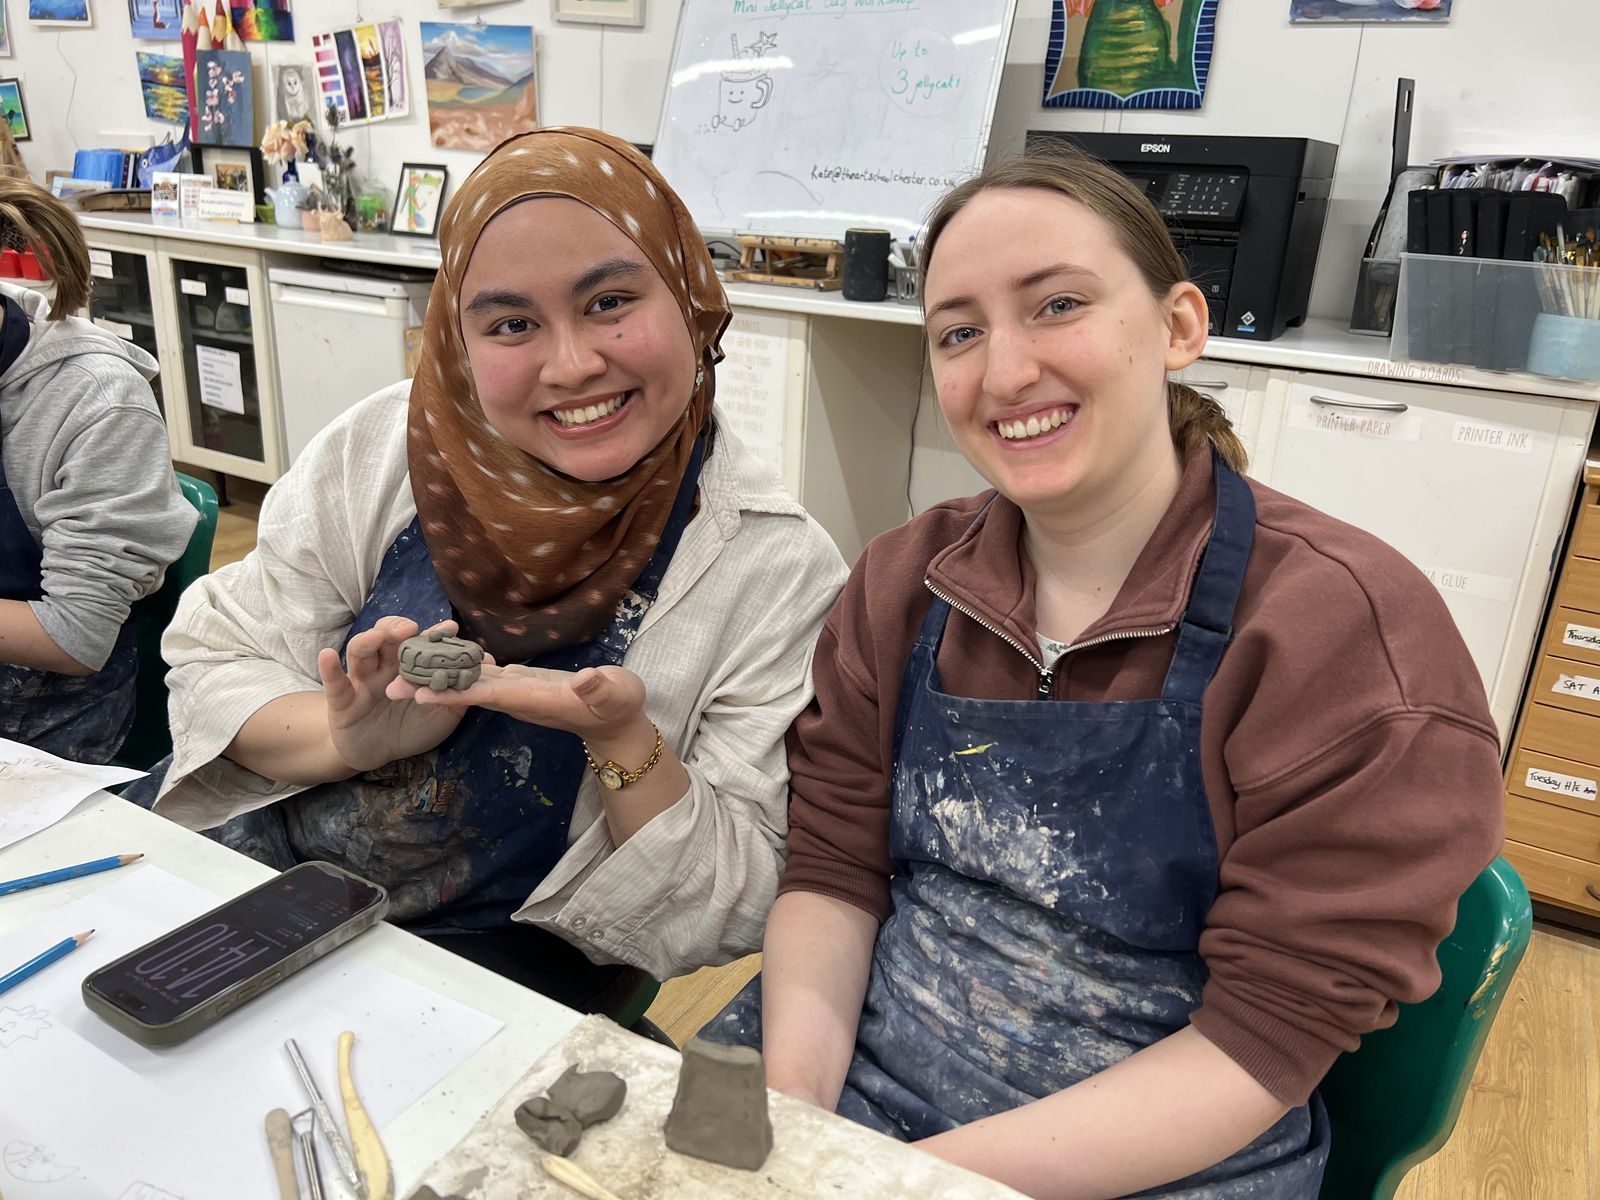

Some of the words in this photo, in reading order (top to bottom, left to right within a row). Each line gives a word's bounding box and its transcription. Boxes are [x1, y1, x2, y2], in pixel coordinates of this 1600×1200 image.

[891, 39, 907, 61] Up
[914, 39, 928, 57] to
[891, 68, 909, 94] 3
[1140, 143, 1171, 153] EPSON
[1367, 360, 1415, 377] DRAWING
[1420, 366, 1462, 381] BOARDS
[1316, 415, 1356, 432] PRINTER
[1359, 419, 1391, 436] PAPER
[1457, 426, 1503, 444] PRINTER
[1507, 432, 1529, 448] INK
[1441, 573, 1468, 589] GLUE
[1563, 680, 1586, 691] SAT
[1530, 771, 1561, 790] Tuesday
